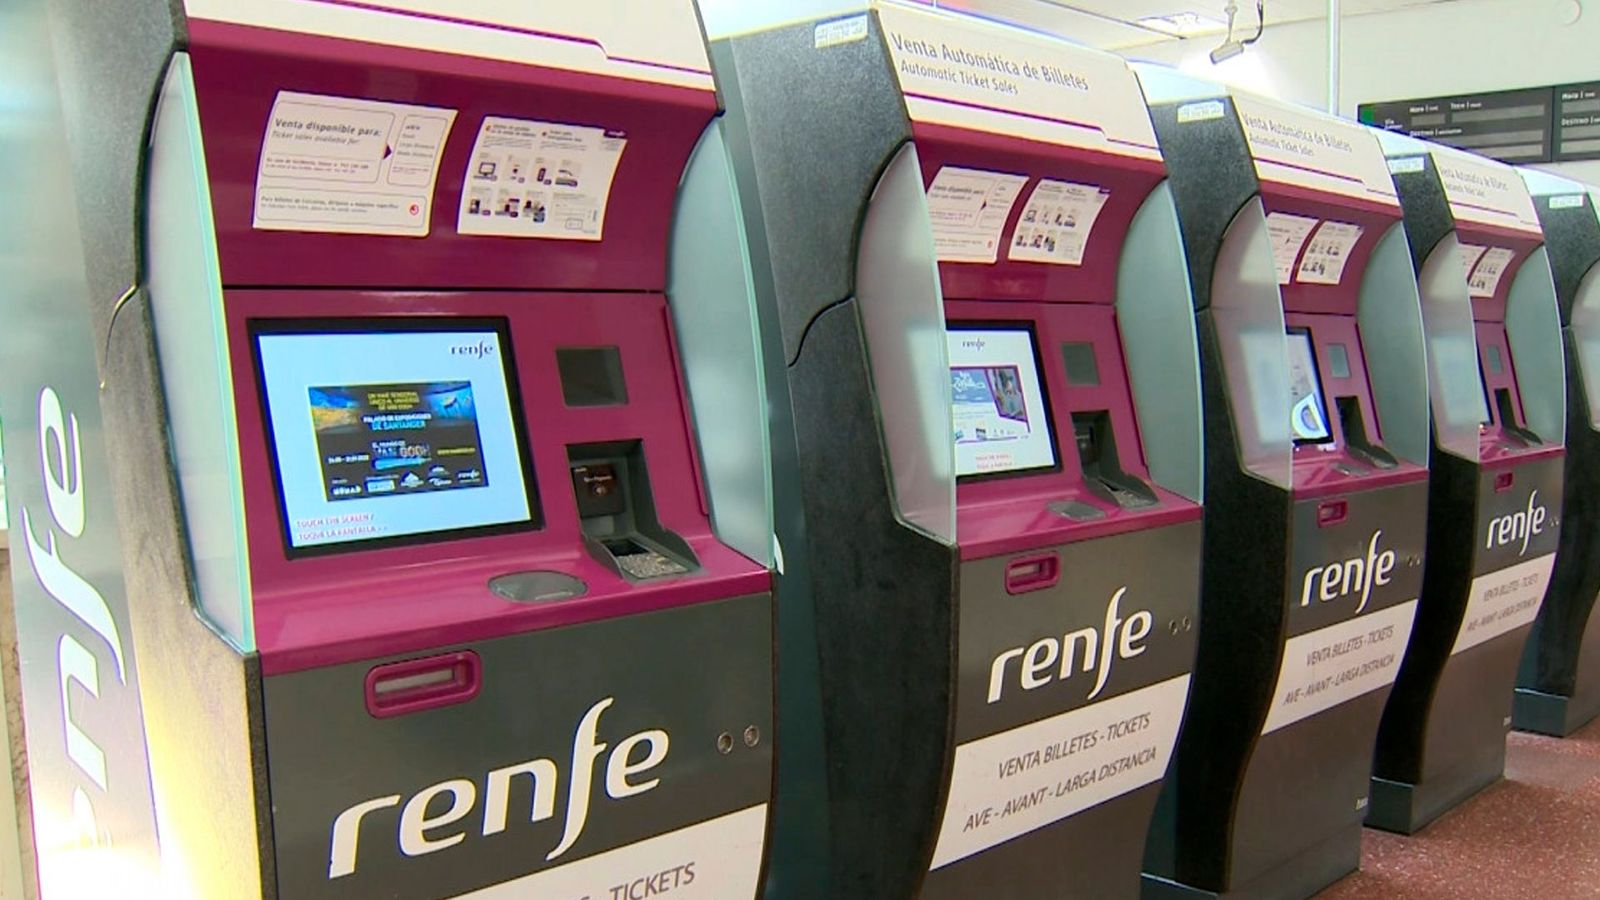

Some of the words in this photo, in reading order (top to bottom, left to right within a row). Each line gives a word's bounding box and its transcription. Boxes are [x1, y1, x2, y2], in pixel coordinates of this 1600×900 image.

[890, 31, 937, 59] Venta
[941, 43, 1020, 76] Automática
[1023, 59, 1039, 80] de
[1042, 65, 1089, 91] Billetes
[900, 59, 956, 83] Automatic
[959, 70, 990, 89] Ticket
[992, 78, 1018, 96] Sales
[275, 117, 303, 129] Venta
[306, 121, 355, 134] disponible
[451, 340, 494, 359] renfe
[1486, 489, 1546, 557] renfe
[1301, 529, 1396, 615] renfe
[987, 585, 1153, 704] renfe
[1306, 647, 1331, 667] VENTA
[1332, 635, 1365, 659] BILLETES
[1368, 624, 1395, 646] TICKETS
[1304, 677, 1332, 701] AVANT
[998, 748, 1040, 780] VENTA
[1043, 730, 1099, 763] BILLETES
[1106, 712, 1151, 742] TICKETS
[328, 697, 670, 880] renfe
[963, 807, 992, 833] AVE
[1001, 787, 1048, 819] AVANT
[1055, 769, 1097, 798] LARGA
[1098, 747, 1157, 780] DISTANCIA
[609, 861, 696, 900] TICKETS
